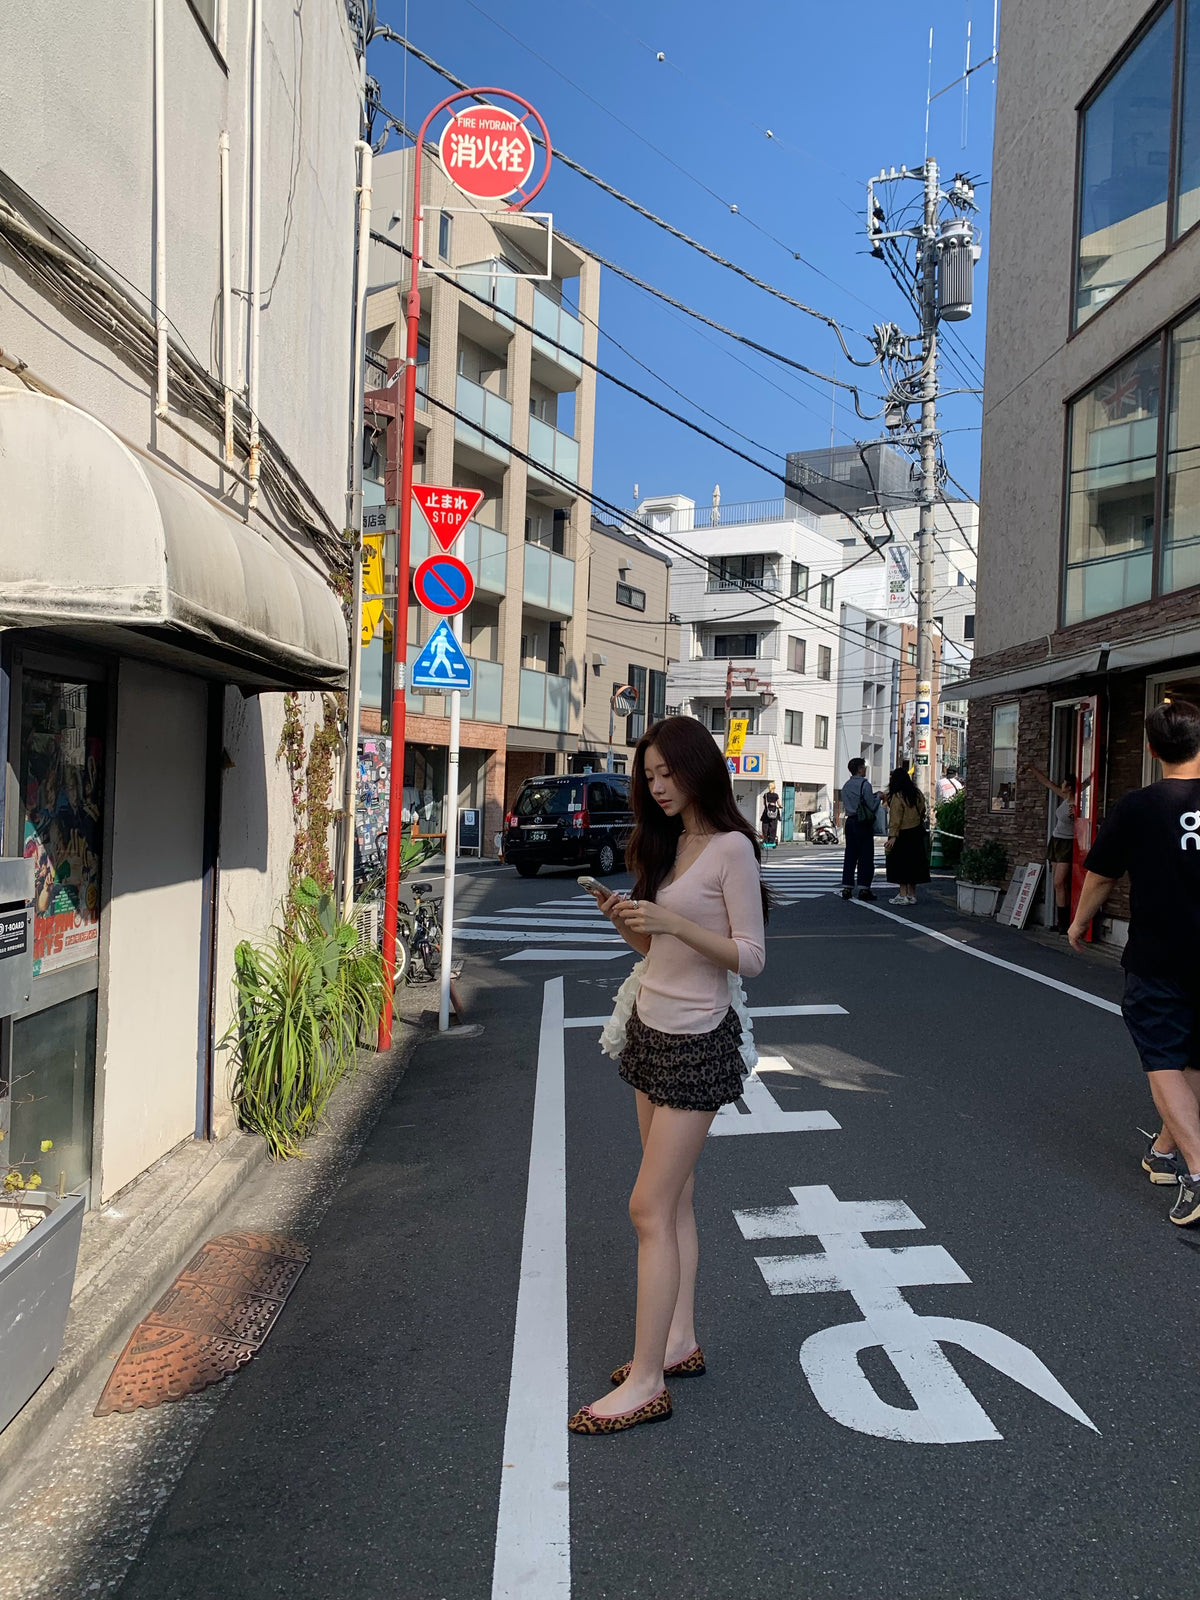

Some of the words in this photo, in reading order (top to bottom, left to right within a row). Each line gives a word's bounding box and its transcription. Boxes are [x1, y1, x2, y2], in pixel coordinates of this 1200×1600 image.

[457, 117, 476, 129] FIRE
[479, 119, 517, 131] HYDRANT
[450, 133, 525, 172] 消火栓
[425, 492, 468, 510] 止まれ
[432, 511, 462, 525] STOP
[917, 704, 929, 724] P
